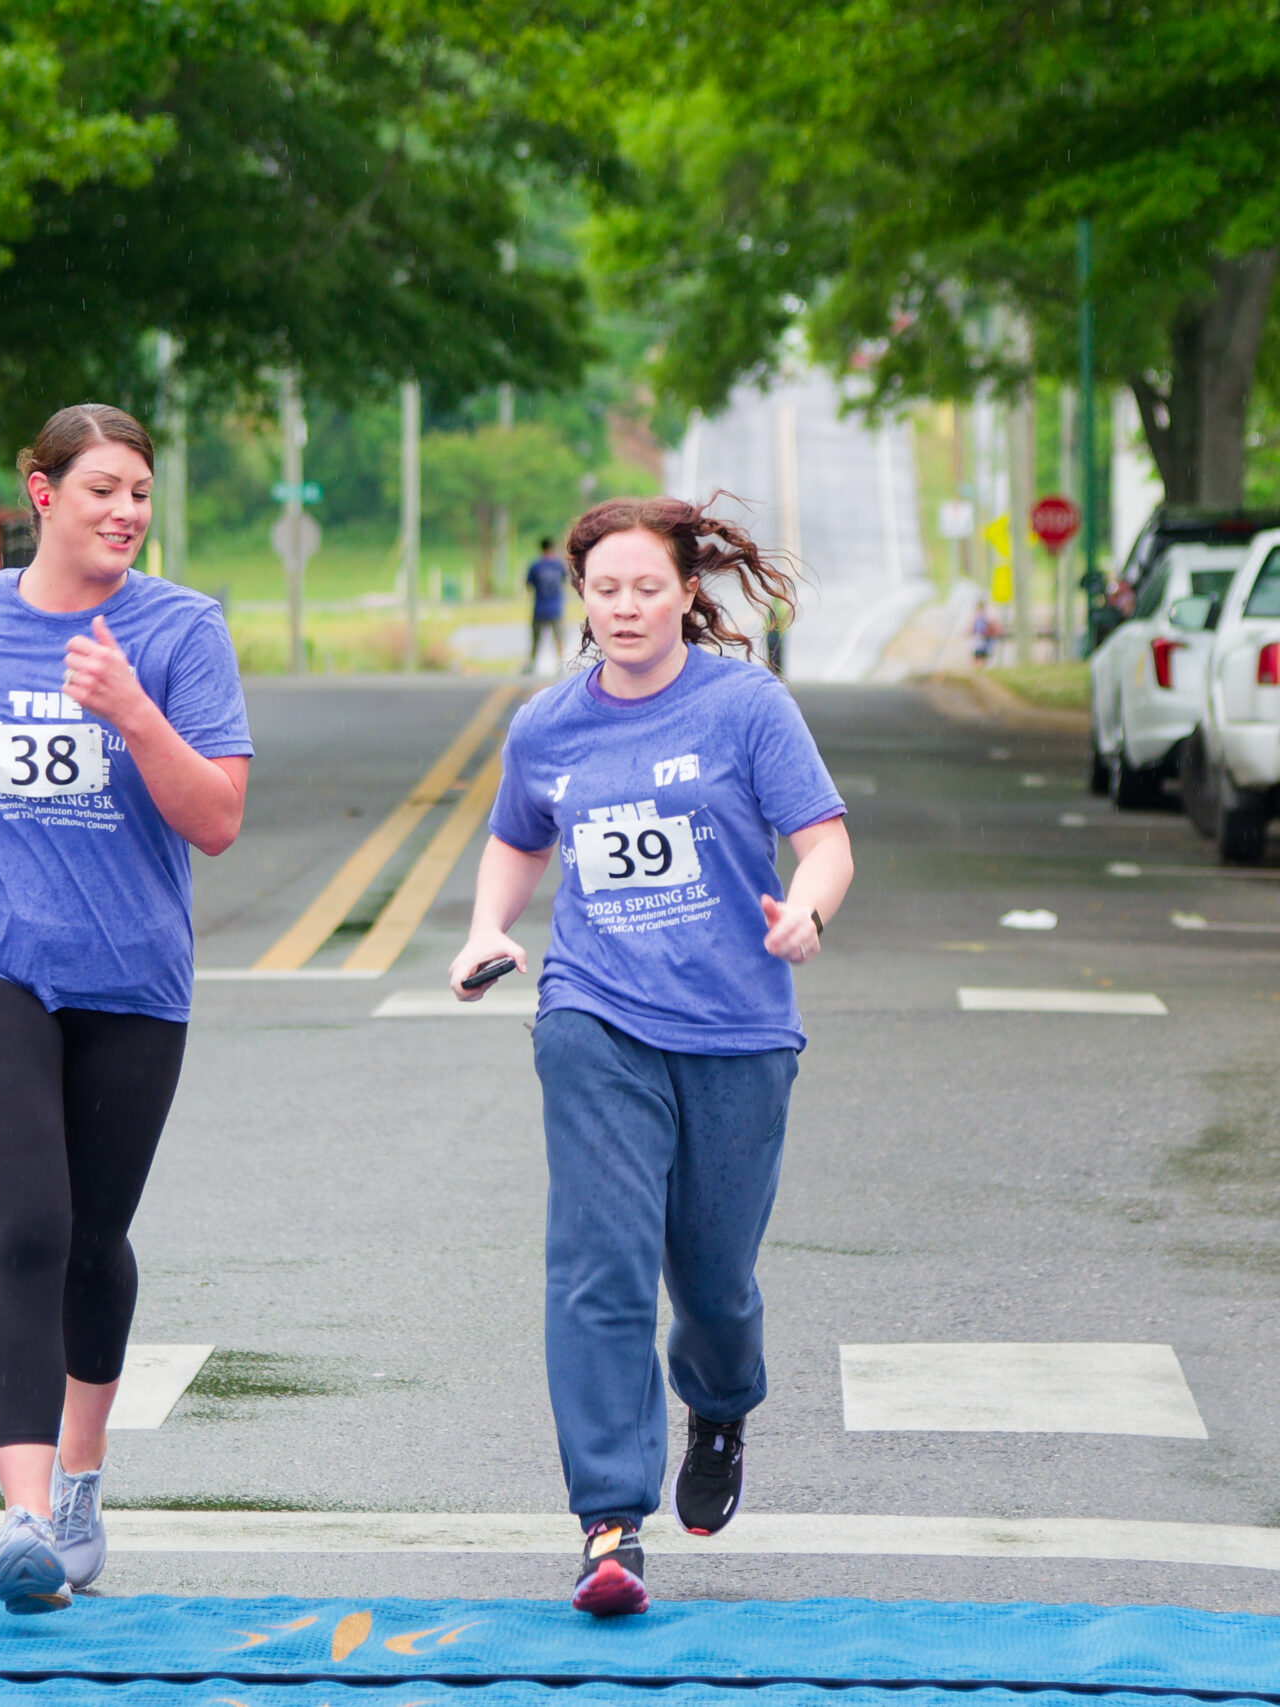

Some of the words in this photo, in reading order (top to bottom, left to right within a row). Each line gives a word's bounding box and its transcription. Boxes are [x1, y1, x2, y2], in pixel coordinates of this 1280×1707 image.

[8, 690, 83, 720] THE
[10, 734, 80, 786] 38
[35, 806, 73, 816] Anniston
[94, 795, 114, 809] 5K
[42, 816, 51, 827] of
[51, 816, 86, 828] Calhoun
[87, 820, 117, 832] County
[691, 826, 716, 842] un
[603, 829, 673, 879] 39
[586, 900, 623, 918] 2026
[625, 889, 683, 912] SPRING
[686, 883, 710, 901] 5K
[629, 909, 667, 923] Anniston
[667, 896, 721, 915] Orthopaedics
[607, 923, 635, 935] YMCA
[636, 921, 647, 934] of
[646, 917, 680, 931] Calhoun
[681, 909, 712, 924] County
